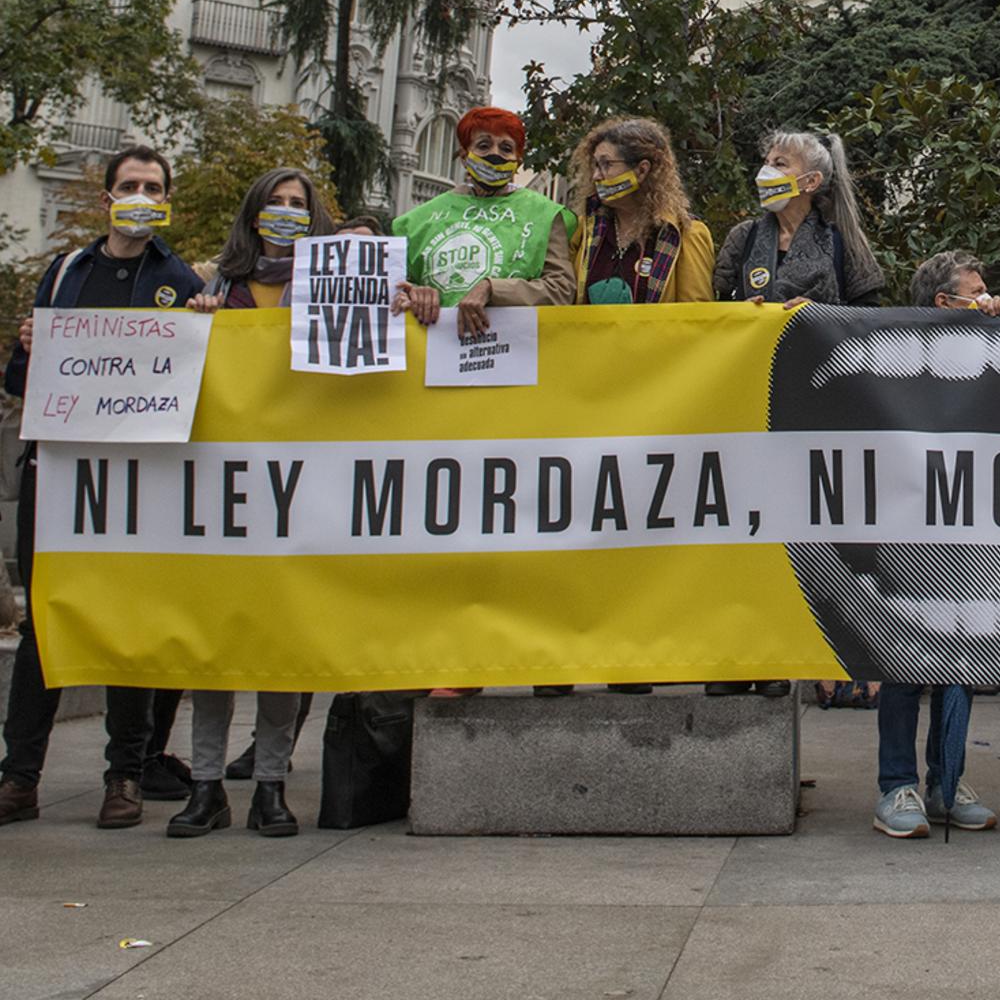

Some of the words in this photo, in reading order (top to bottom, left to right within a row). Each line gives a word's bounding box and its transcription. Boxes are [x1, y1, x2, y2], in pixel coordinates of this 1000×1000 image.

[463, 205, 516, 223] CASA
[310, 240, 351, 276] LEY
[359, 241, 389, 276] DE
[437, 245, 480, 267] STOP
[310, 277, 389, 305] VIVIENDA
[308, 305, 389, 368] ¡YA!
[59, 356, 136, 376] CONTRA
[152, 356, 172, 374] LA
[459, 358, 495, 373] adecuada
[43, 393, 79, 423] LEY
[96, 396, 179, 415] MORDAZA
[74, 458, 140, 535] NI
[183, 460, 304, 538] LEY
[351, 451, 761, 537] MORDAZA,
[809, 449, 877, 526] NI
